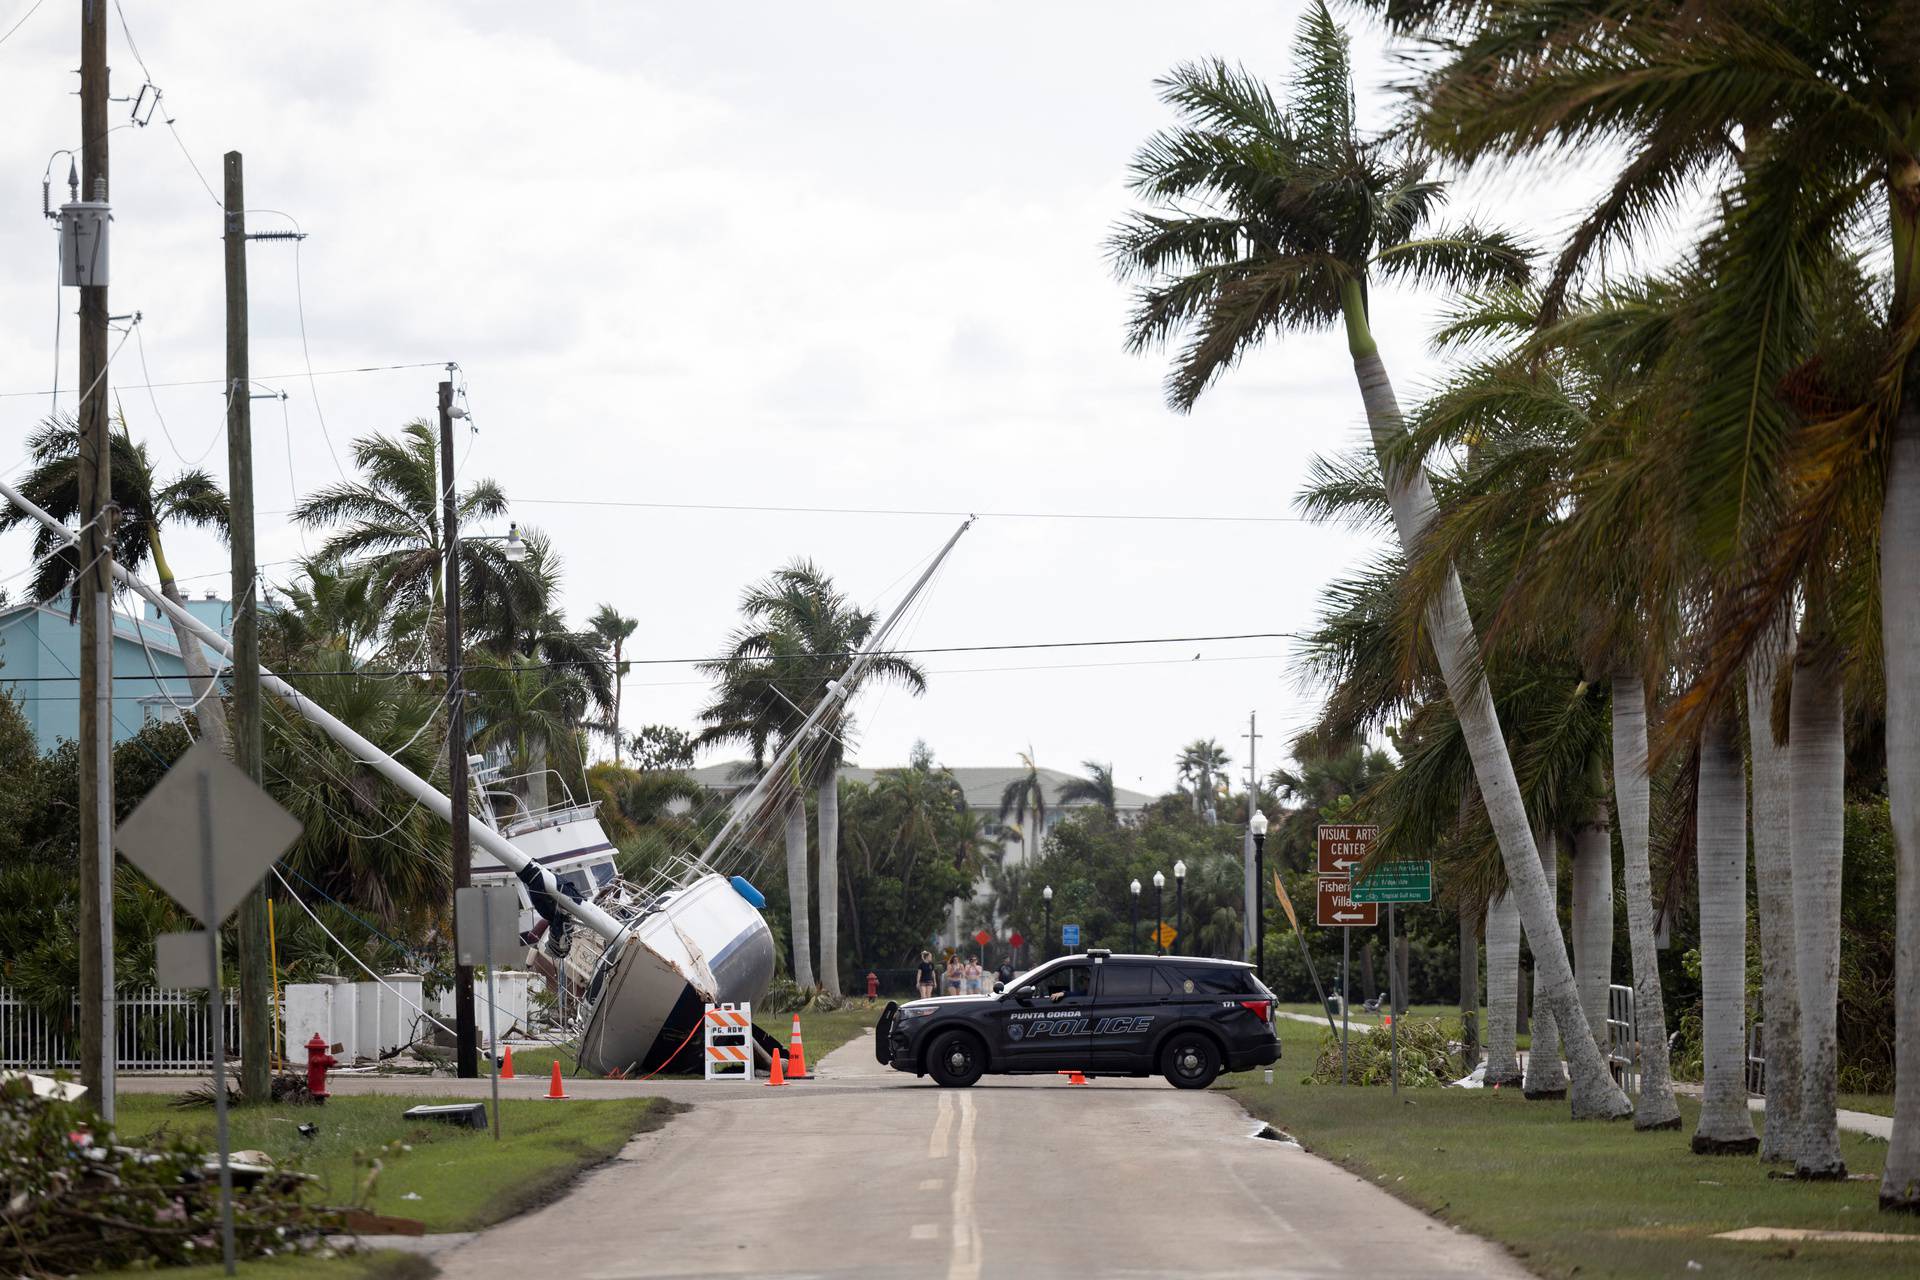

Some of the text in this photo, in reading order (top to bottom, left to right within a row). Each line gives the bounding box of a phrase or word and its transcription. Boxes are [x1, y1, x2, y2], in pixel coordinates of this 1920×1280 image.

[1320, 828, 1377, 840] VISUAL ARTS
[1331, 843, 1366, 855] CENTER
[1319, 880, 1351, 893] Fisher
[1010, 1012, 1045, 1020] PUNTA
[1025, 1016, 1155, 1038] POLICE
